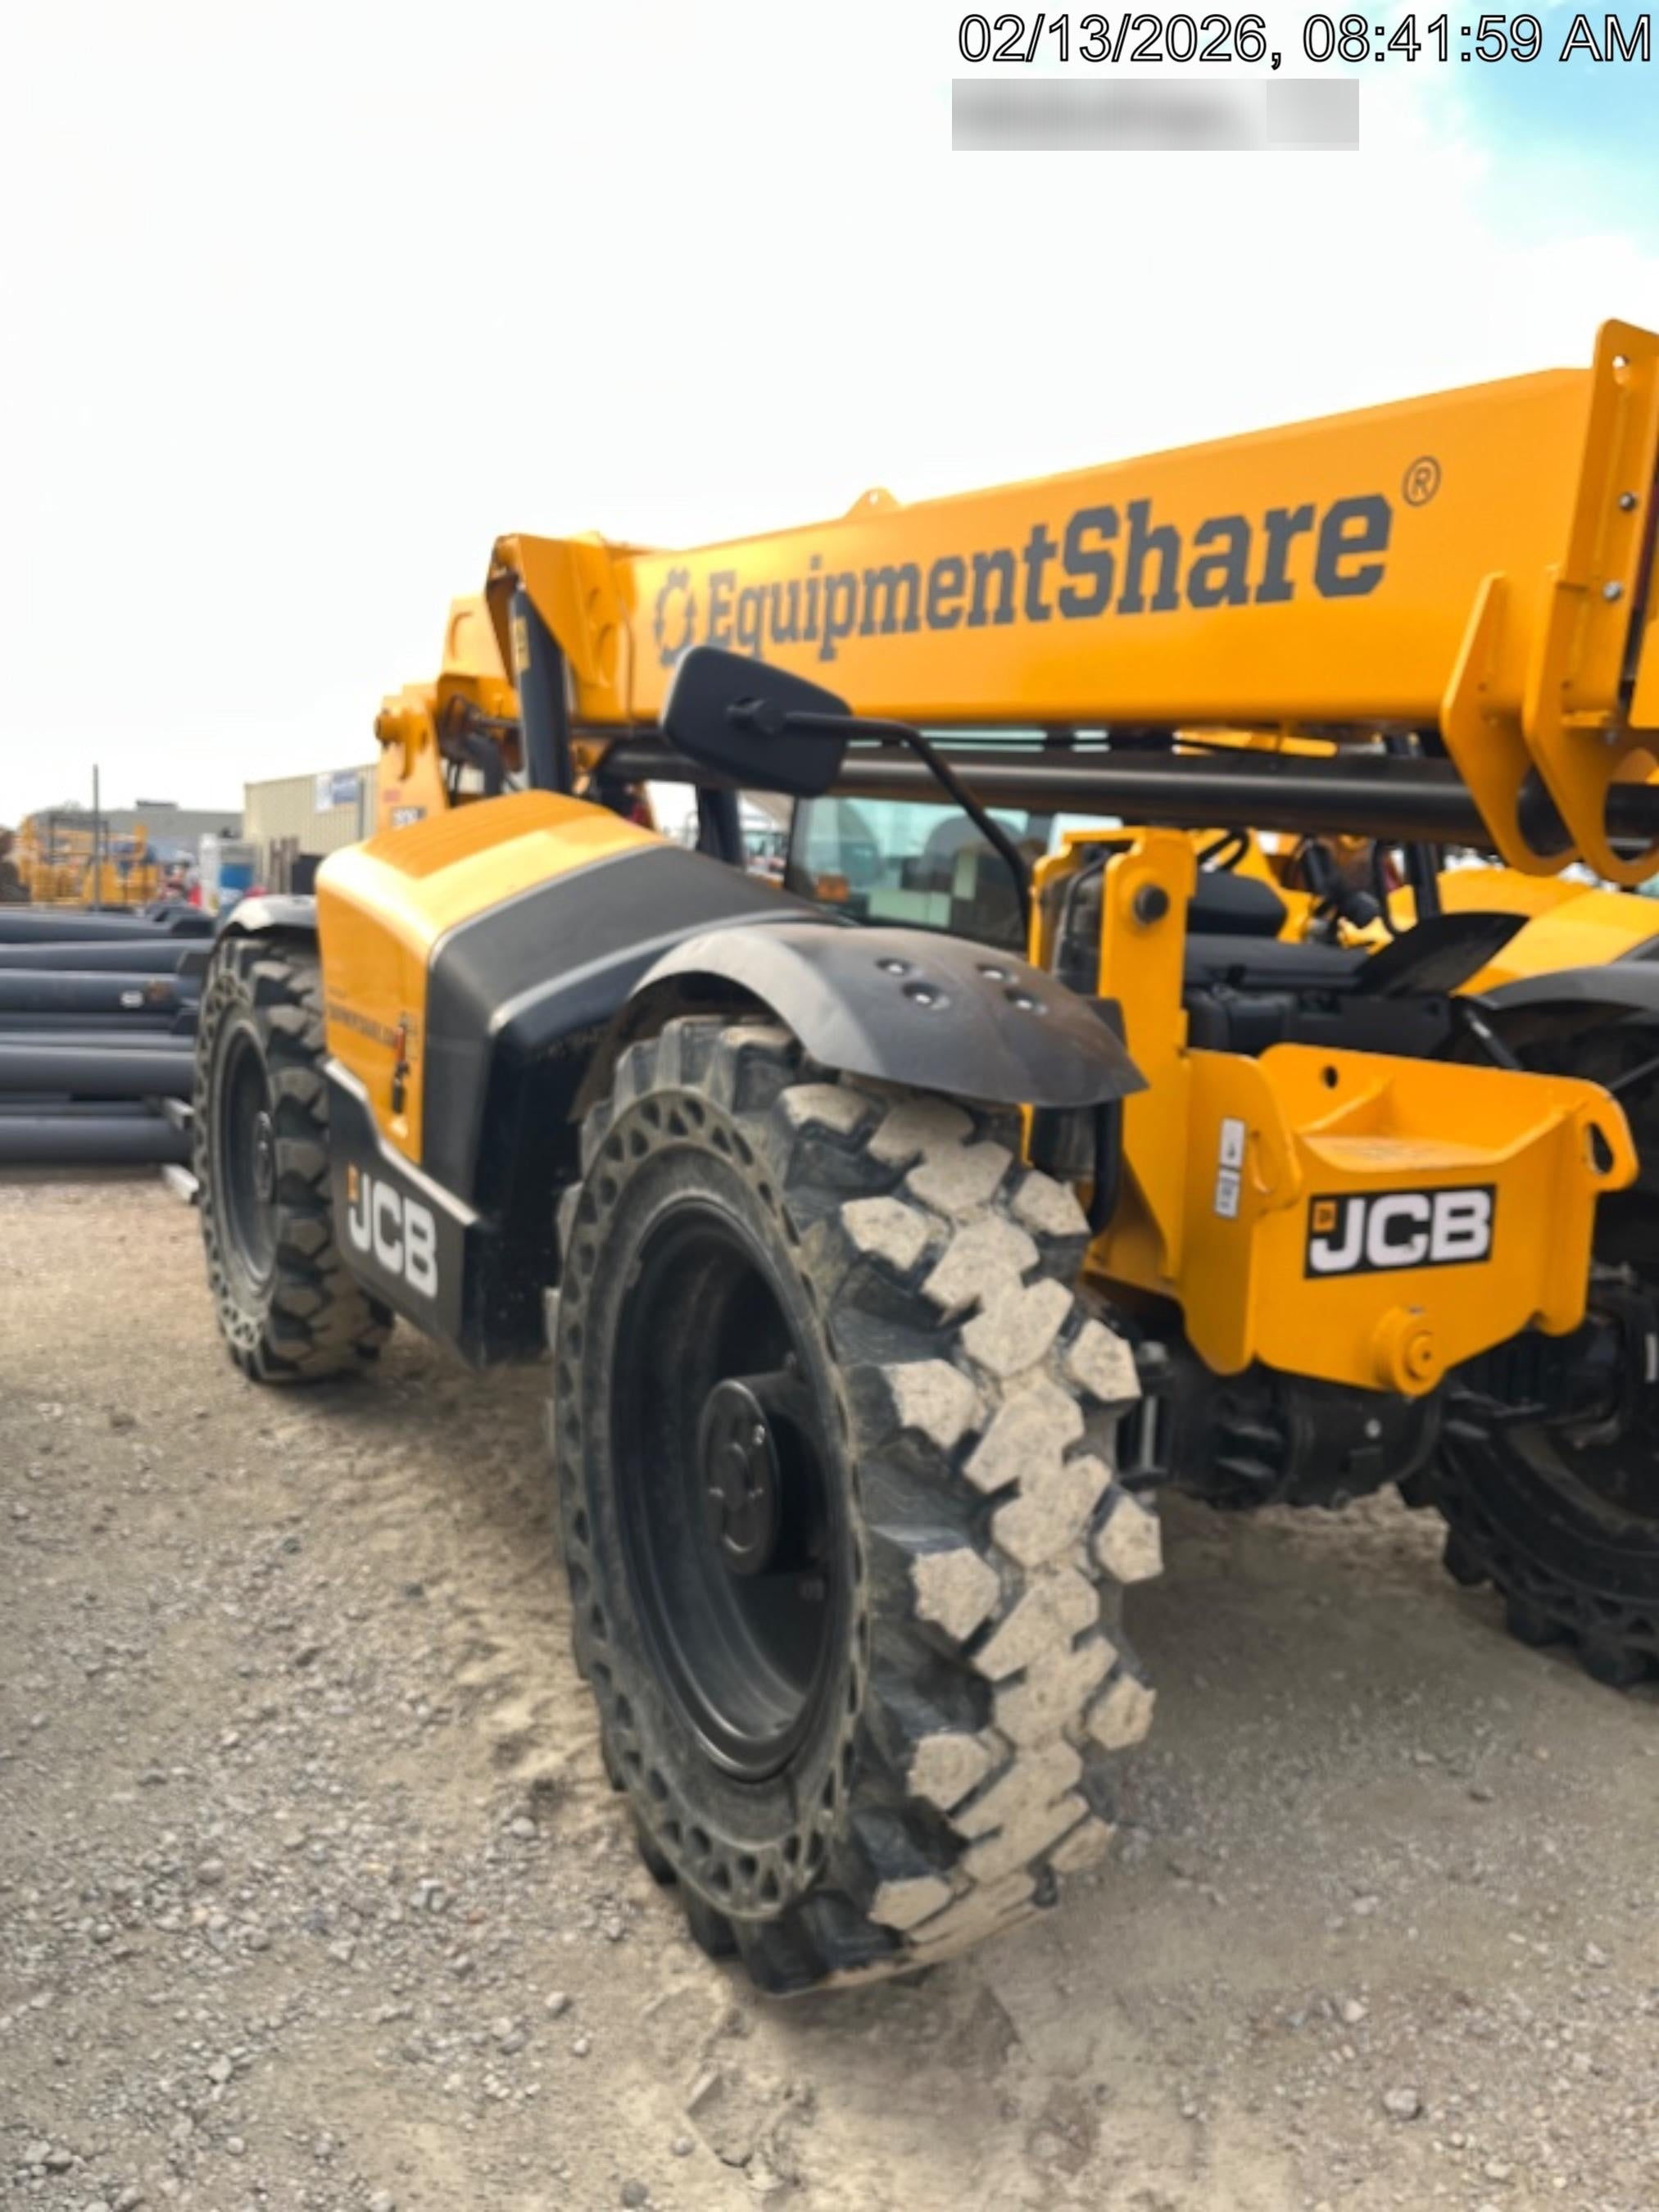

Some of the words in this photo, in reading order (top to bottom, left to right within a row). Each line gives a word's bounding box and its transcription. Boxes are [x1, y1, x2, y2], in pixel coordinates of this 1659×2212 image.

[706, 493, 1393, 660] EquipmentShare
[347, 1172, 438, 1298] JCB
[1310, 1190, 1491, 1271] JCB
